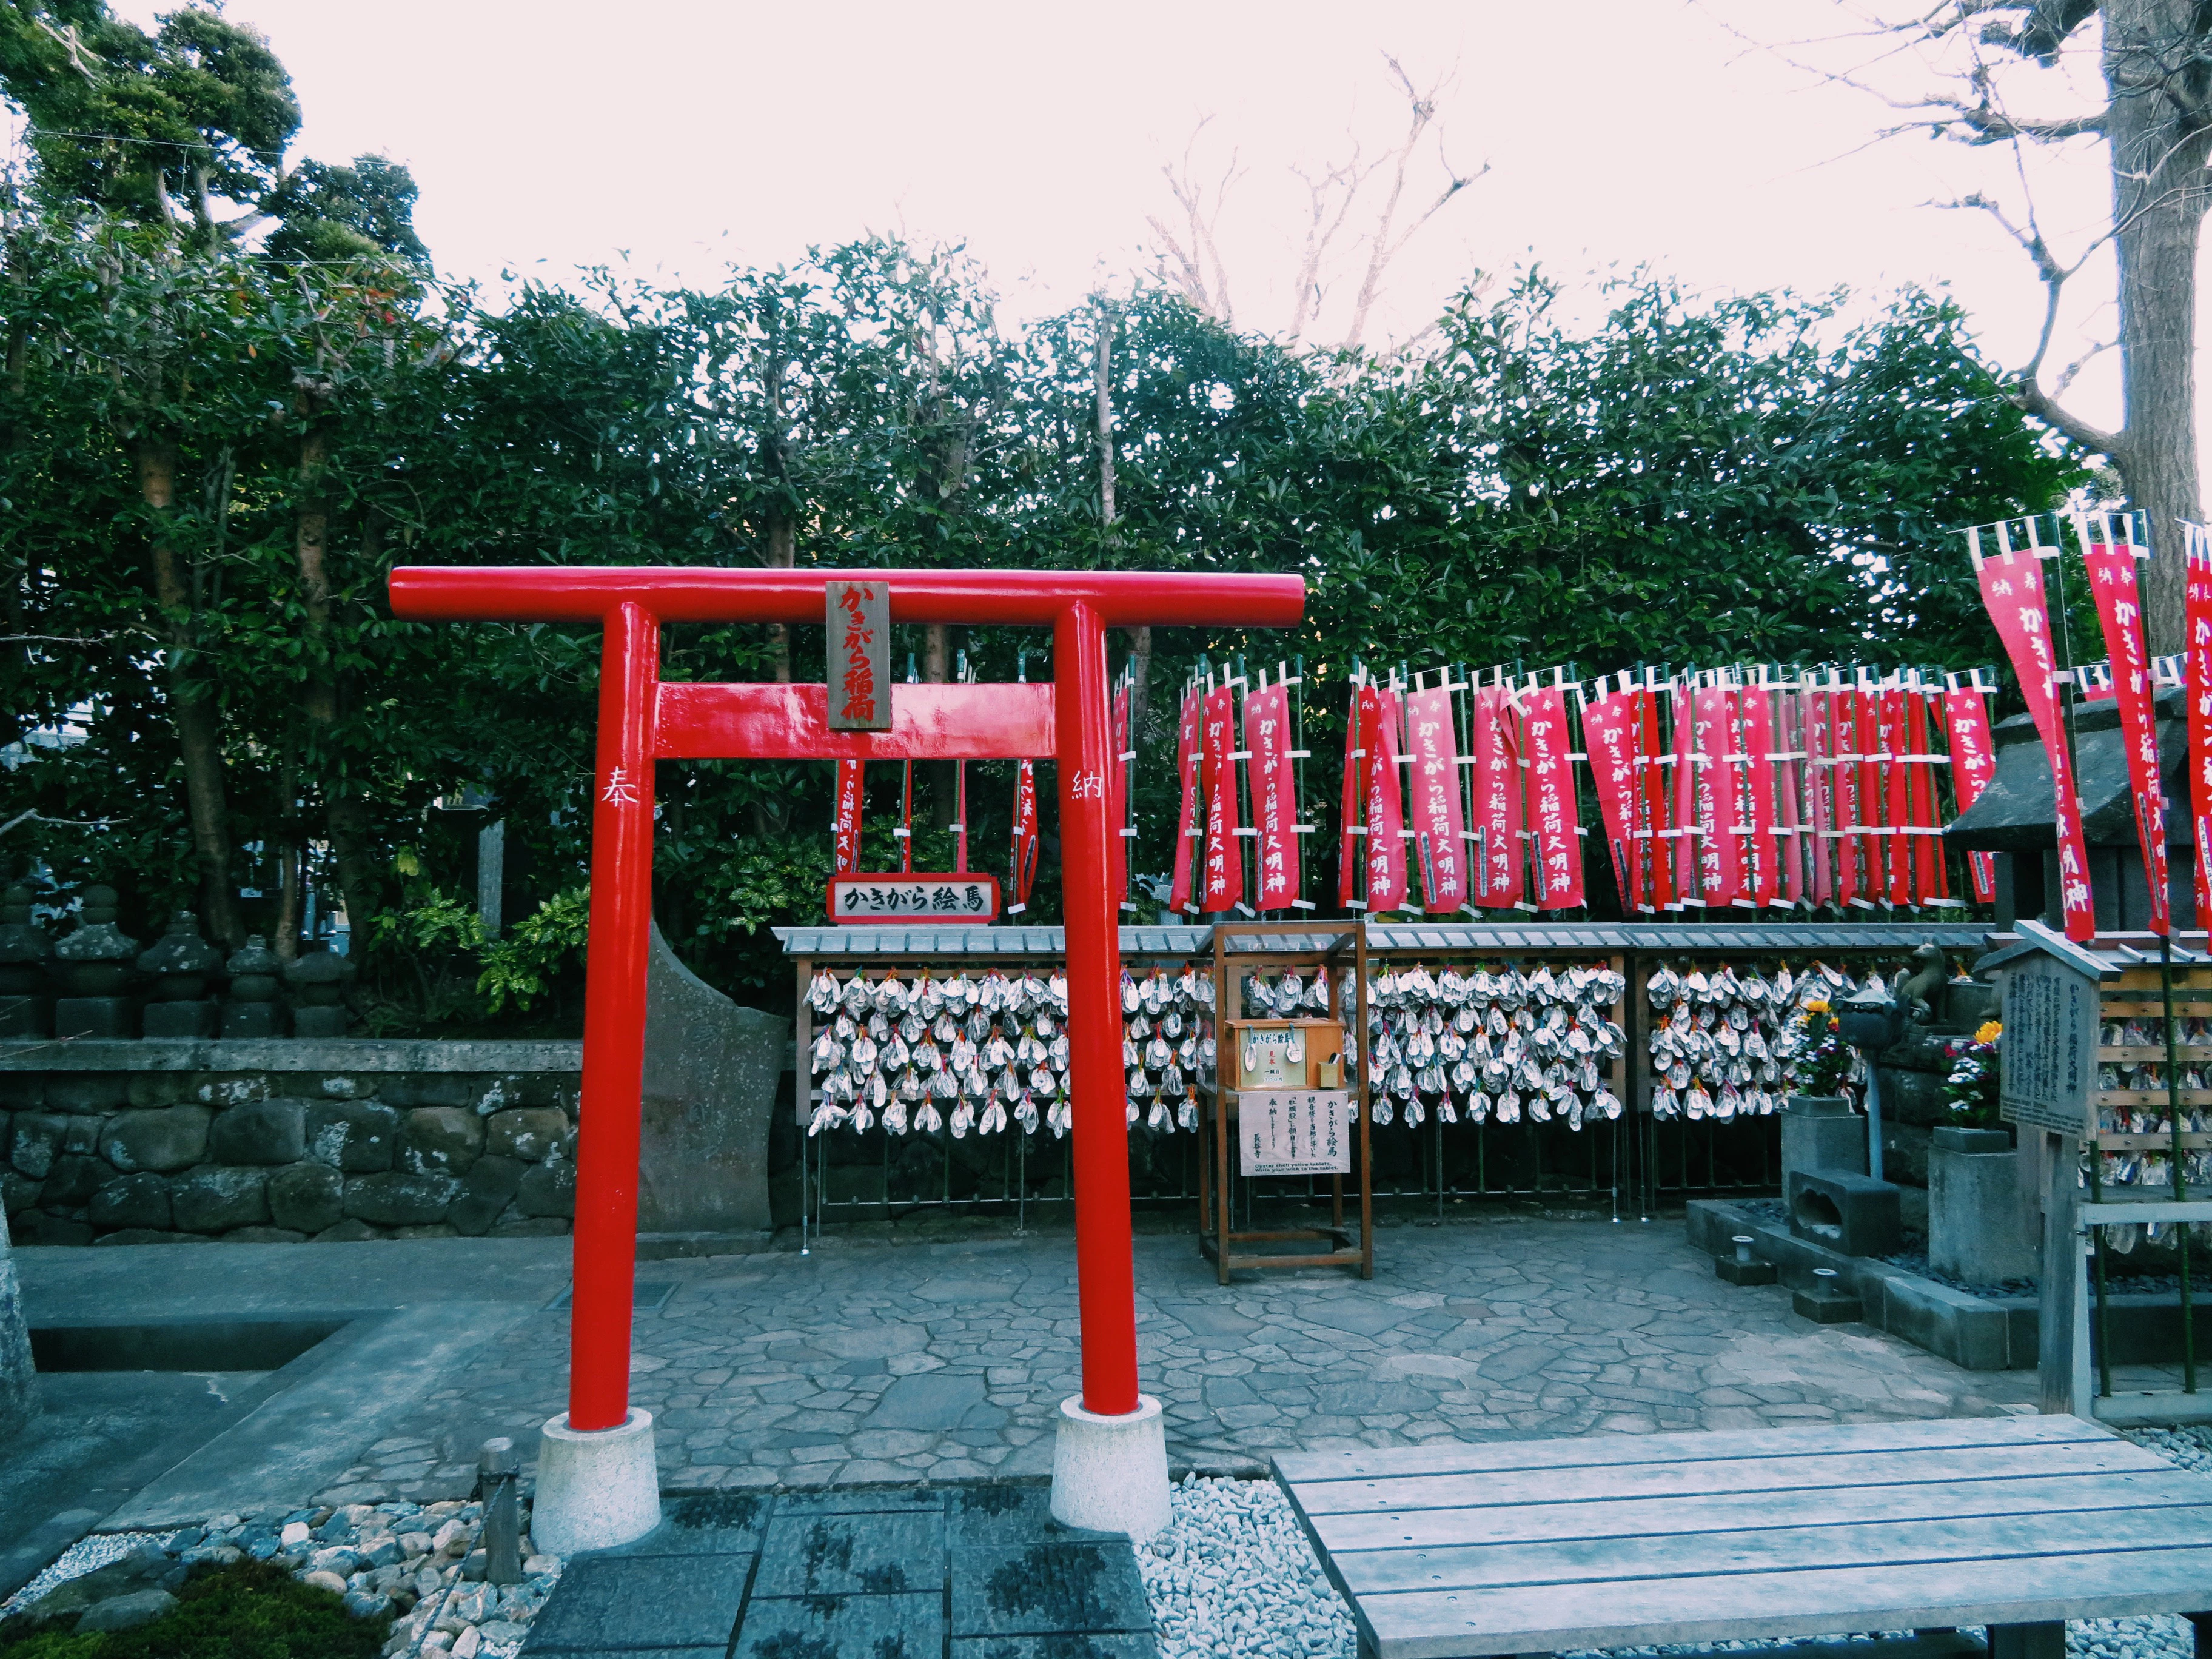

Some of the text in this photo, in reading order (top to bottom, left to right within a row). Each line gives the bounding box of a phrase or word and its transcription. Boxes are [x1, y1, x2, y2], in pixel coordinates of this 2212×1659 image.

[838, 586, 876, 721] かきがら稲荷
[602, 766, 638, 807] 奉
[1071, 770, 1102, 799] 納
[1418, 721, 1457, 897] かきがら稲荷大明神
[1531, 720, 1571, 893] かきがら稲荷大明神
[845, 885, 984, 912] かきがら絵馬
[1253, 1133, 1262, 1159] 長谷寺
[1326, 1100, 1338, 1157] かきがら絵馬
